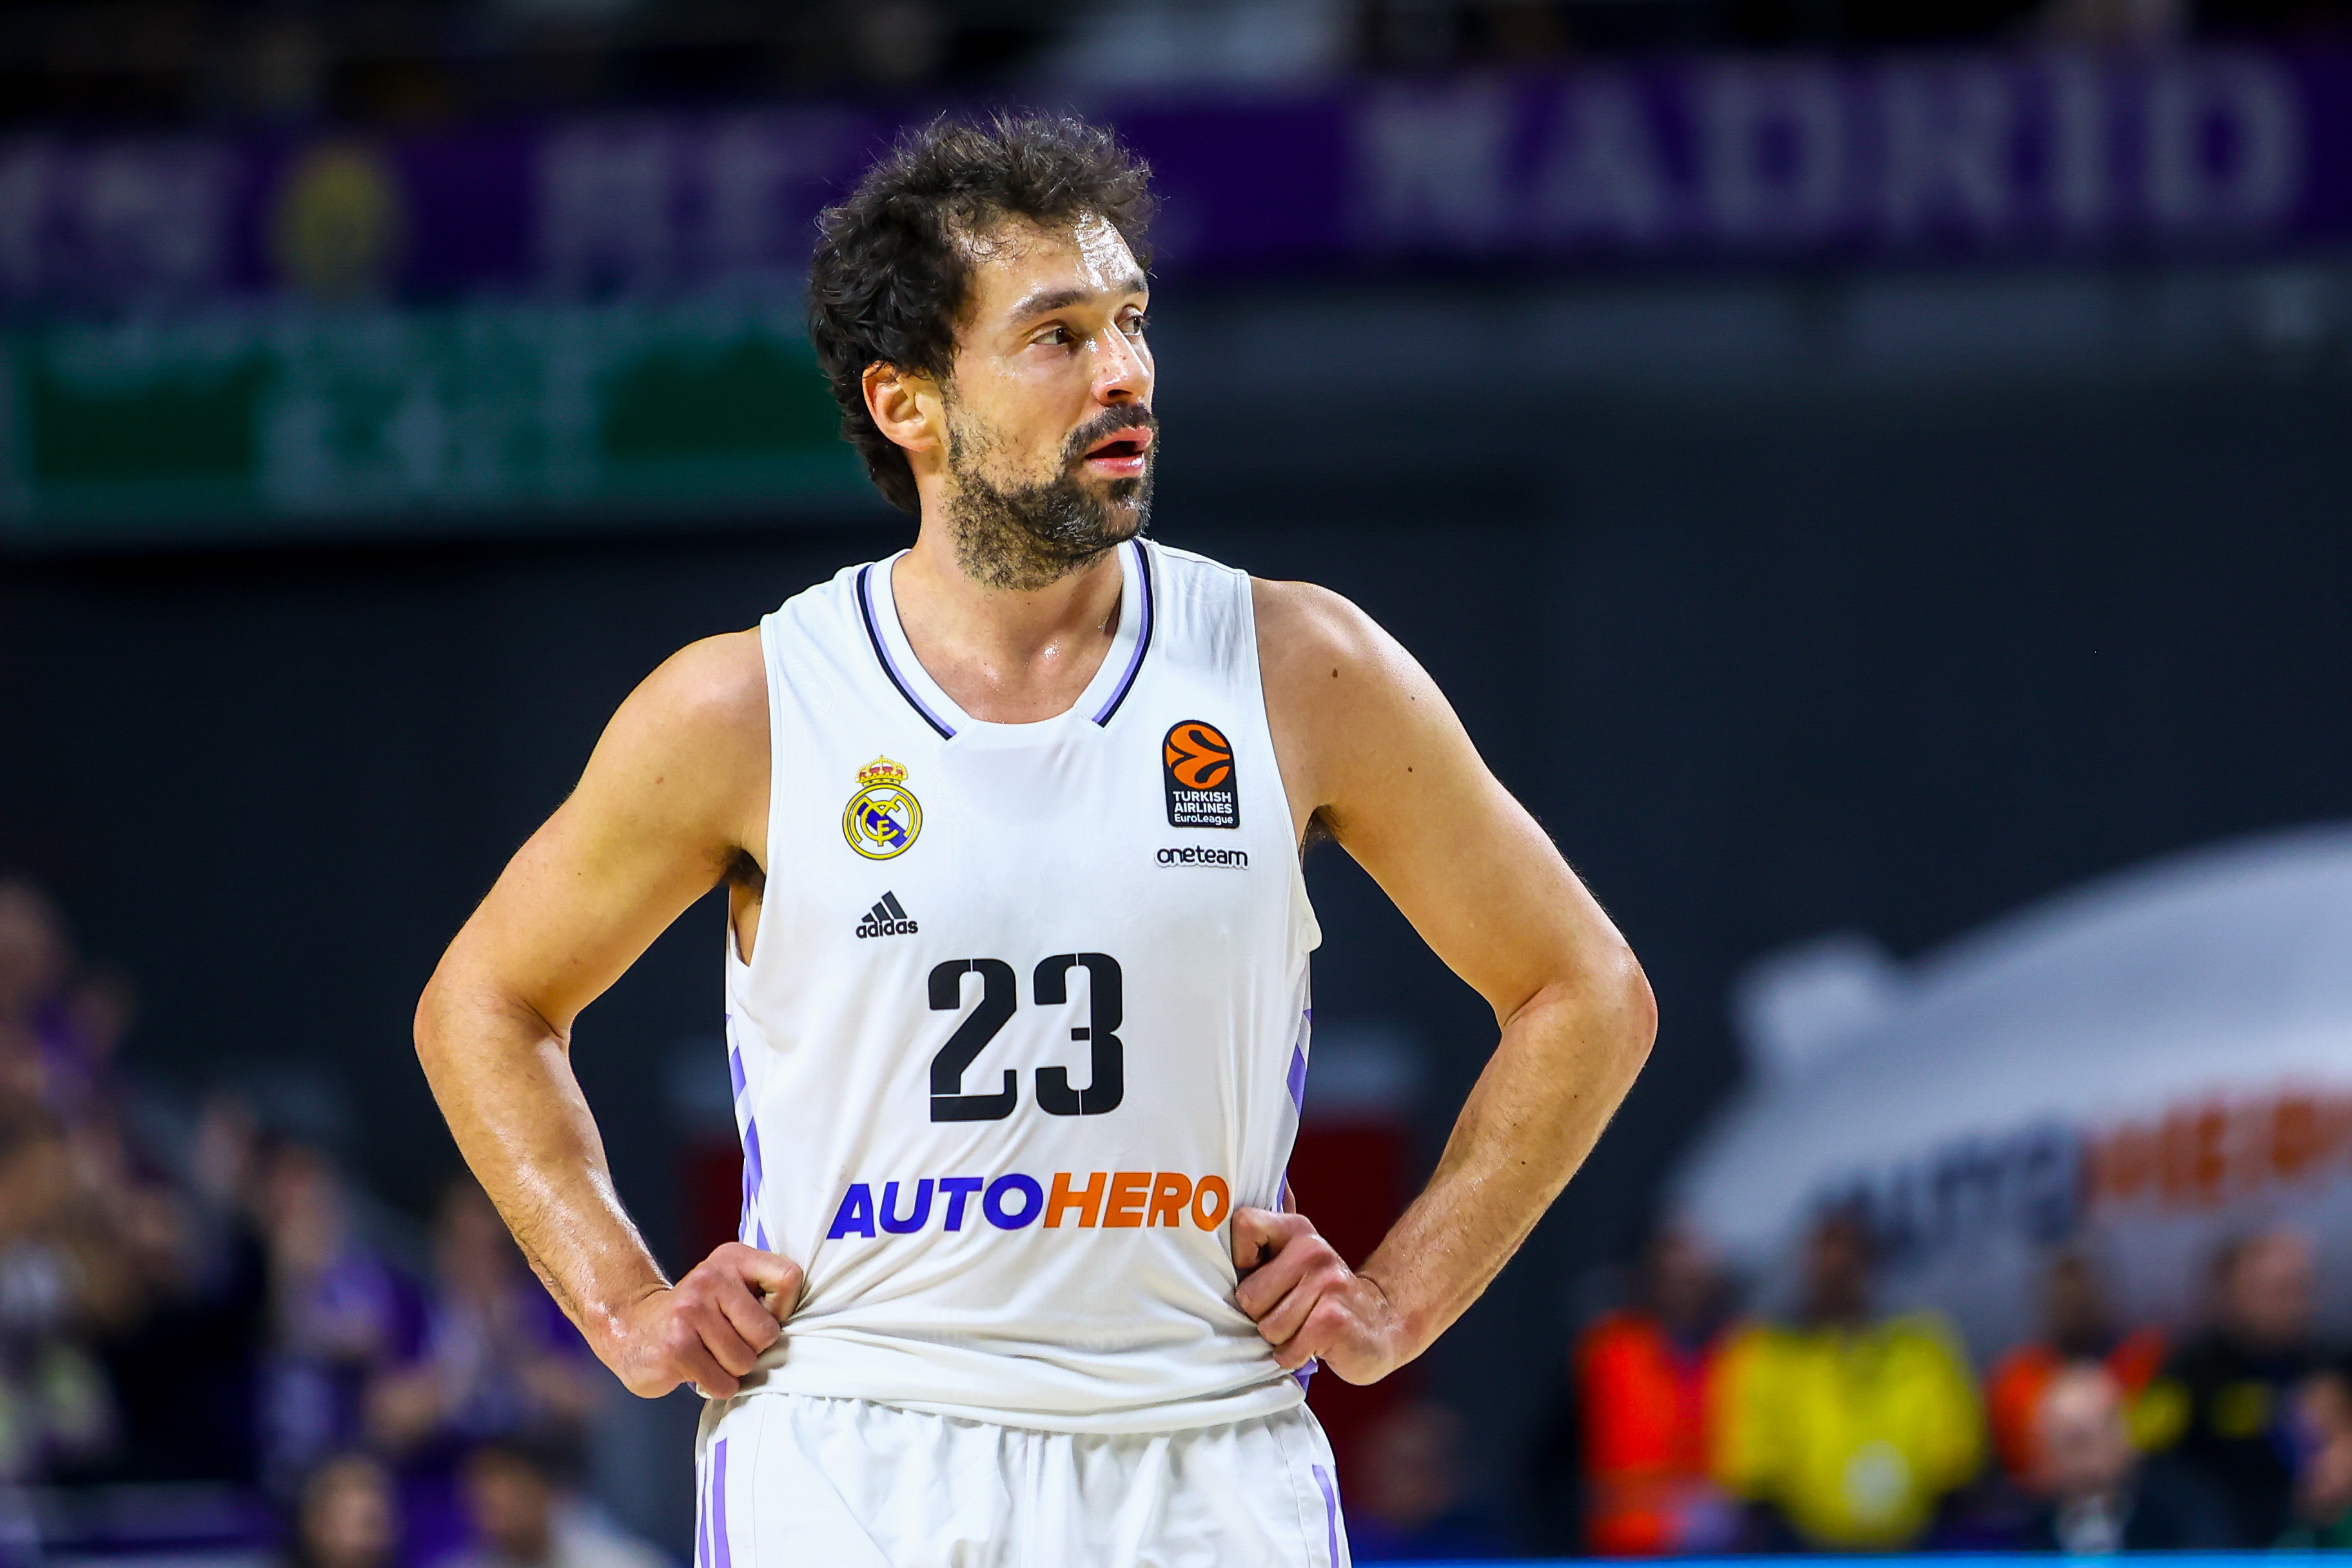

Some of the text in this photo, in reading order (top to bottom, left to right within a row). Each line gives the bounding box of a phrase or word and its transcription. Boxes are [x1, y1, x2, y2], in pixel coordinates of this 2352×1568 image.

[1351, 53, 2303, 240] MADRID
[1173, 791, 1231, 802] TURKISH
[1174, 802, 1233, 814] AIRLINES
[1174, 813, 1233, 826] EuroLeague
[1157, 845, 1249, 867] oneteam
[856, 918, 919, 939] adidas
[927, 952, 1124, 1123] 23
[826, 1172, 1230, 1240] AUTOHERO
